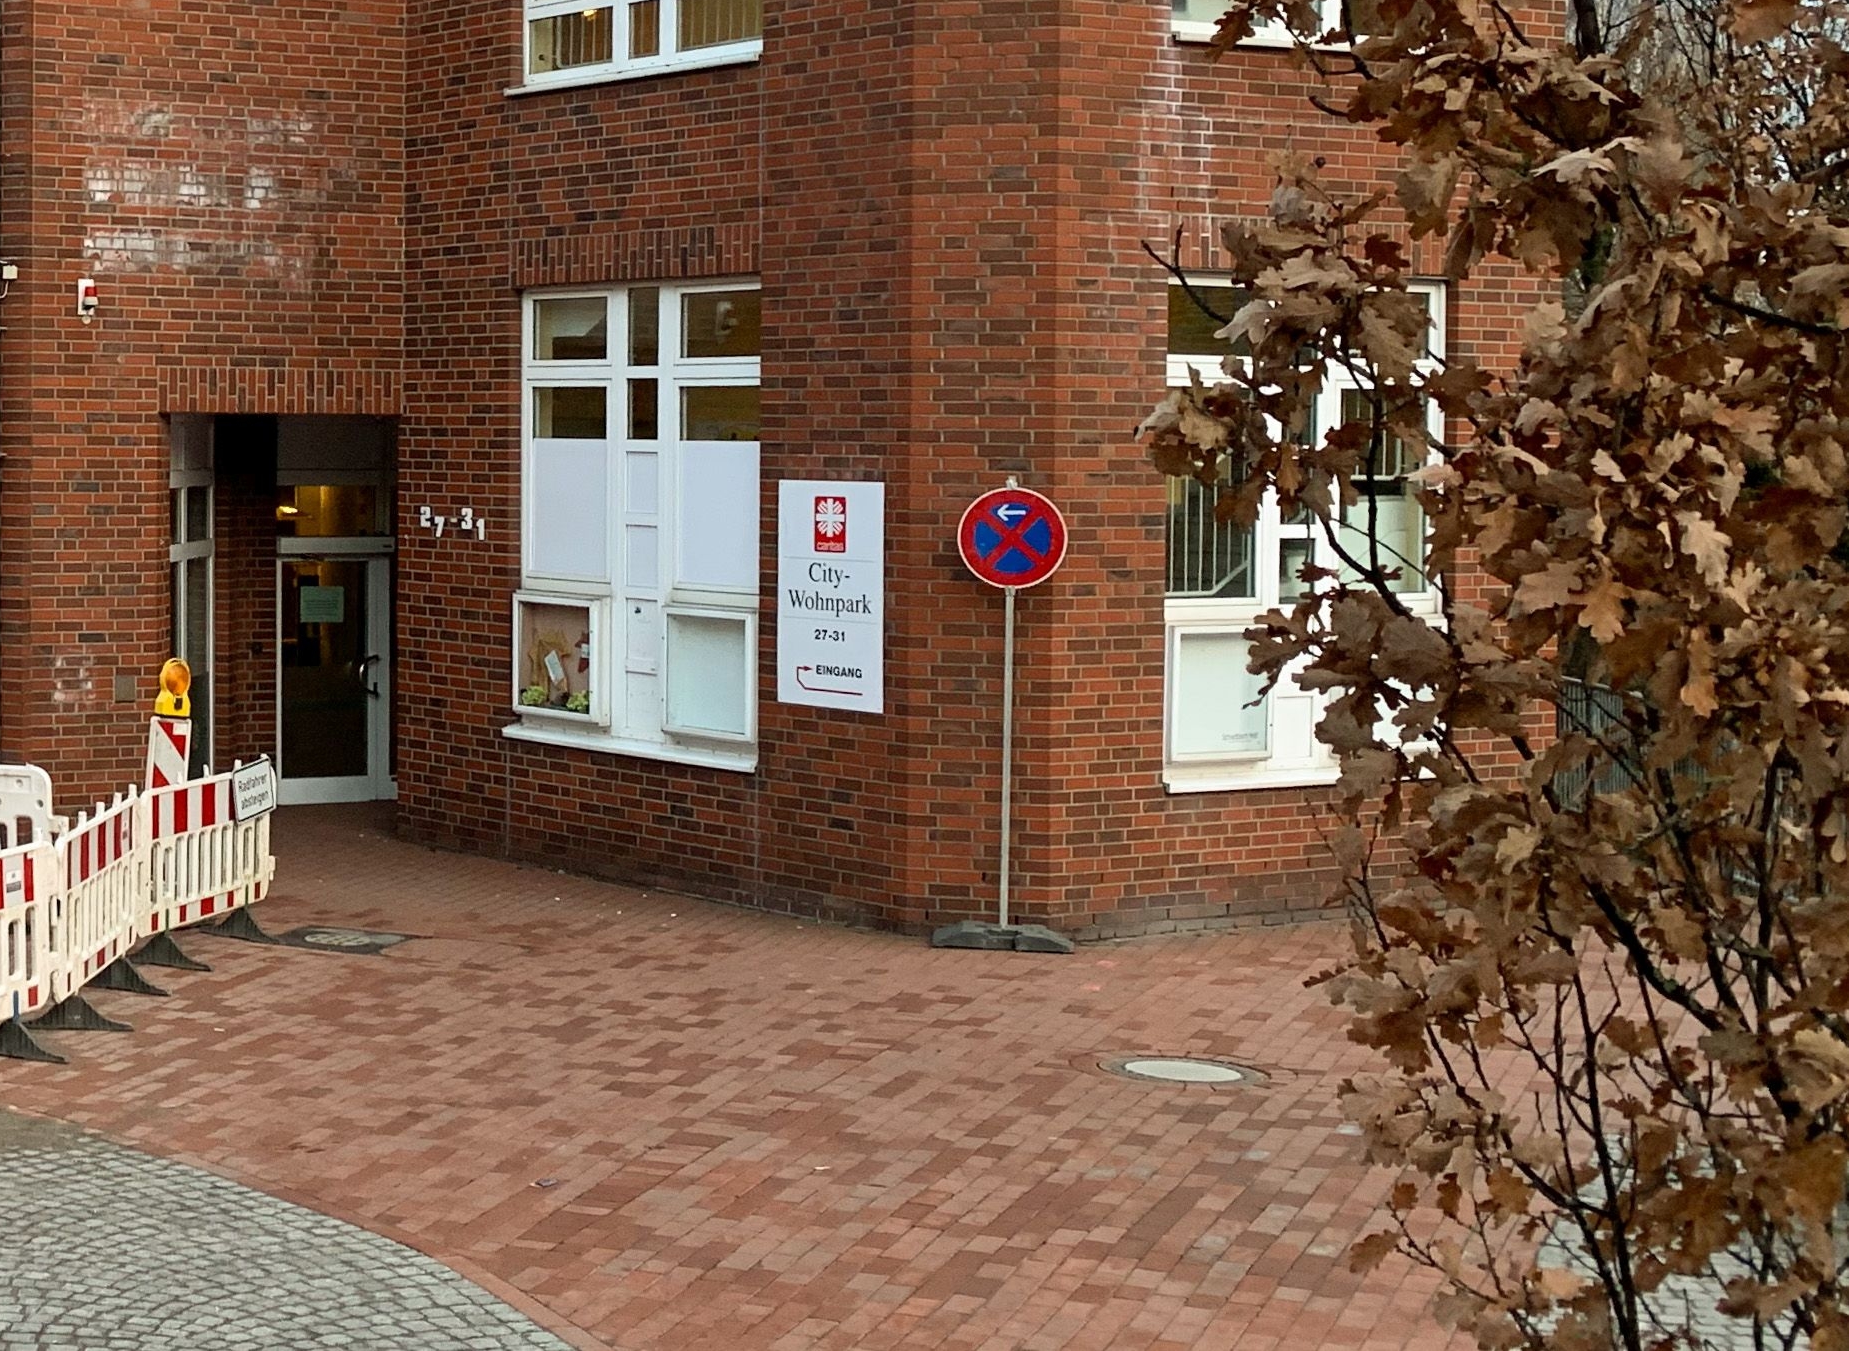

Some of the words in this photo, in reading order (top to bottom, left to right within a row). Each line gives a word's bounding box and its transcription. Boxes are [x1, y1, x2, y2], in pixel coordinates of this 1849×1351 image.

[808, 561, 851, 589] City-
[788, 589, 872, 618] Wohnpark
[814, 628, 846, 642] 27-31
[815, 664, 863, 679] EINGANG
